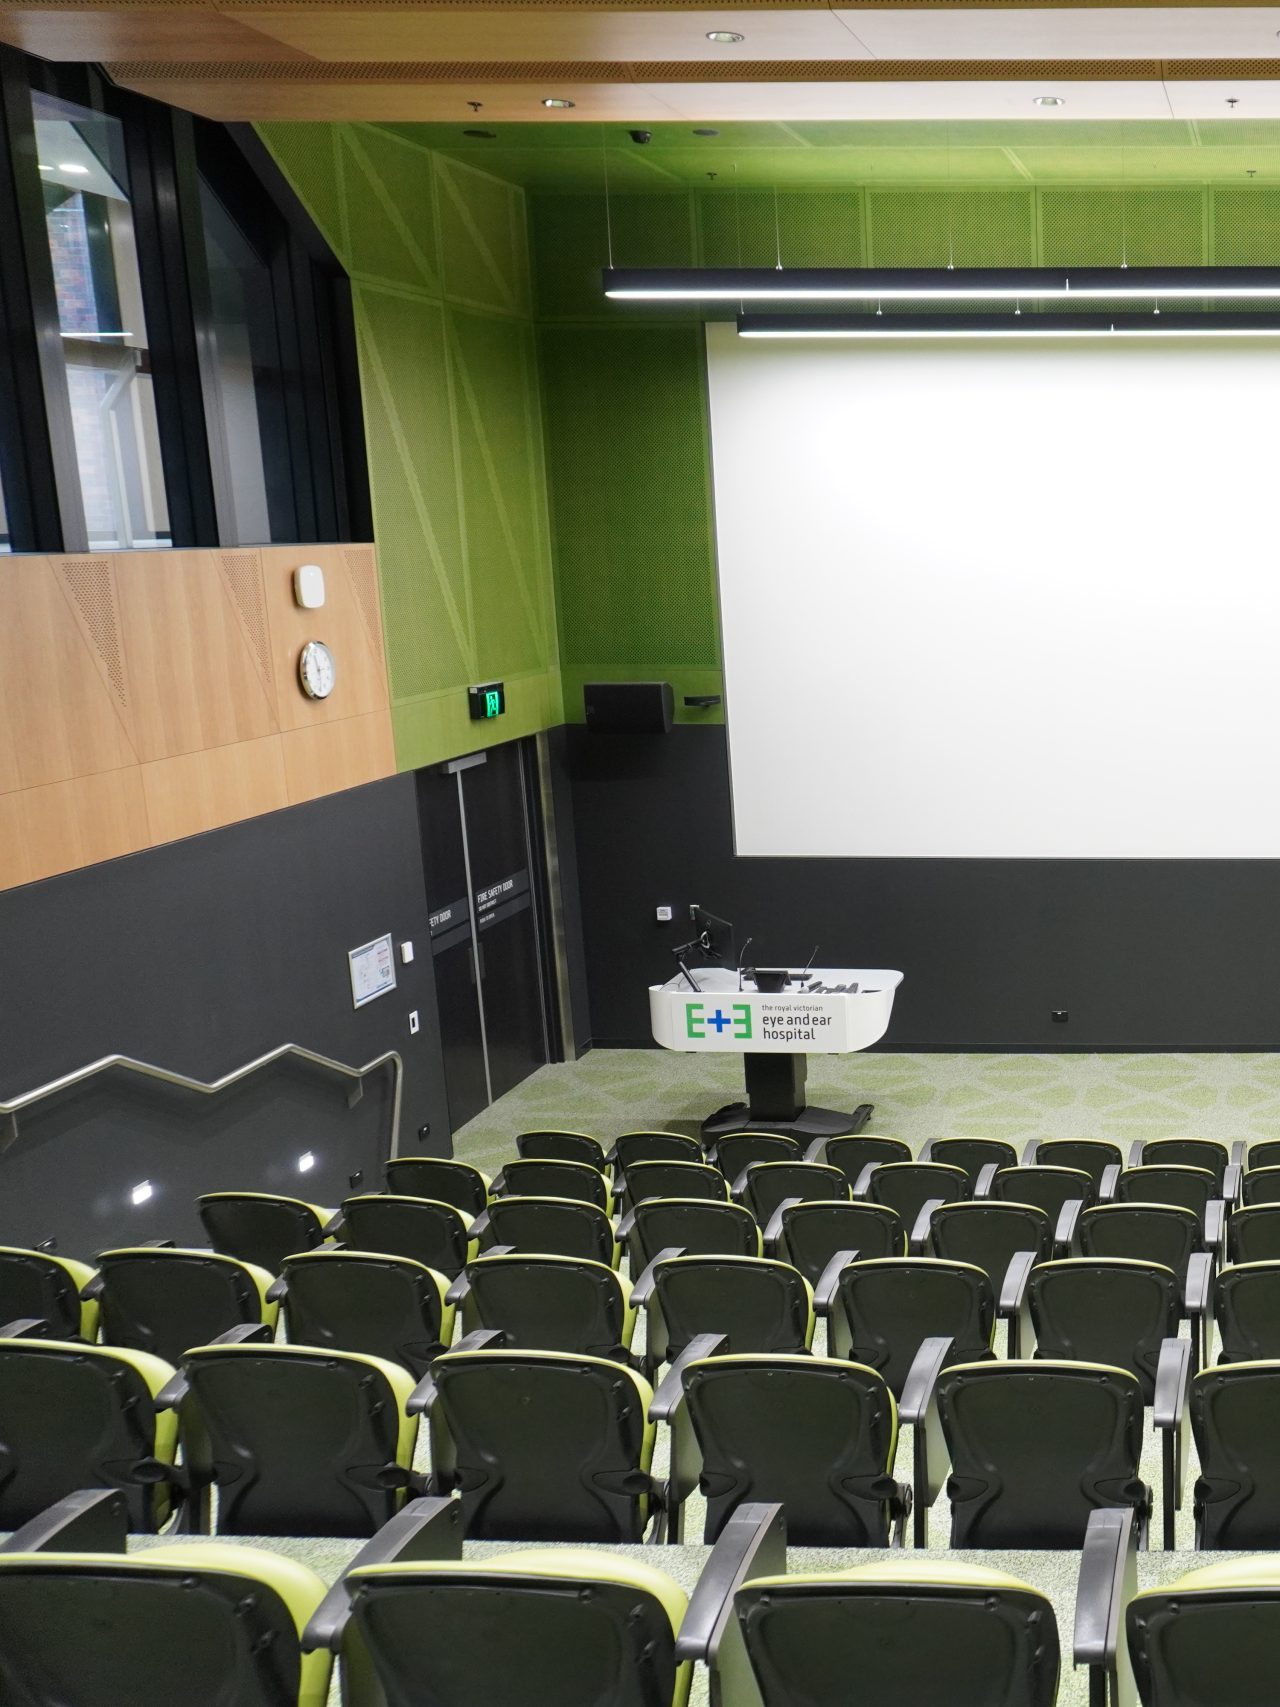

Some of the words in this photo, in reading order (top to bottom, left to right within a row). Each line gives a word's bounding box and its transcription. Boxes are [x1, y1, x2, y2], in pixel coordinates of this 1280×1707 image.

[477, 891, 488, 903] FIRE
[488, 884, 503, 899] SAFETY
[503, 879, 514, 892] DOOR
[439, 909, 452, 923] DOOR
[774, 1004, 792, 1012] royal
[762, 1016, 784, 1027] eye
[786, 1013, 810, 1026] and
[812, 1016, 832, 1026] ear
[763, 1027, 816, 1042] hospital
